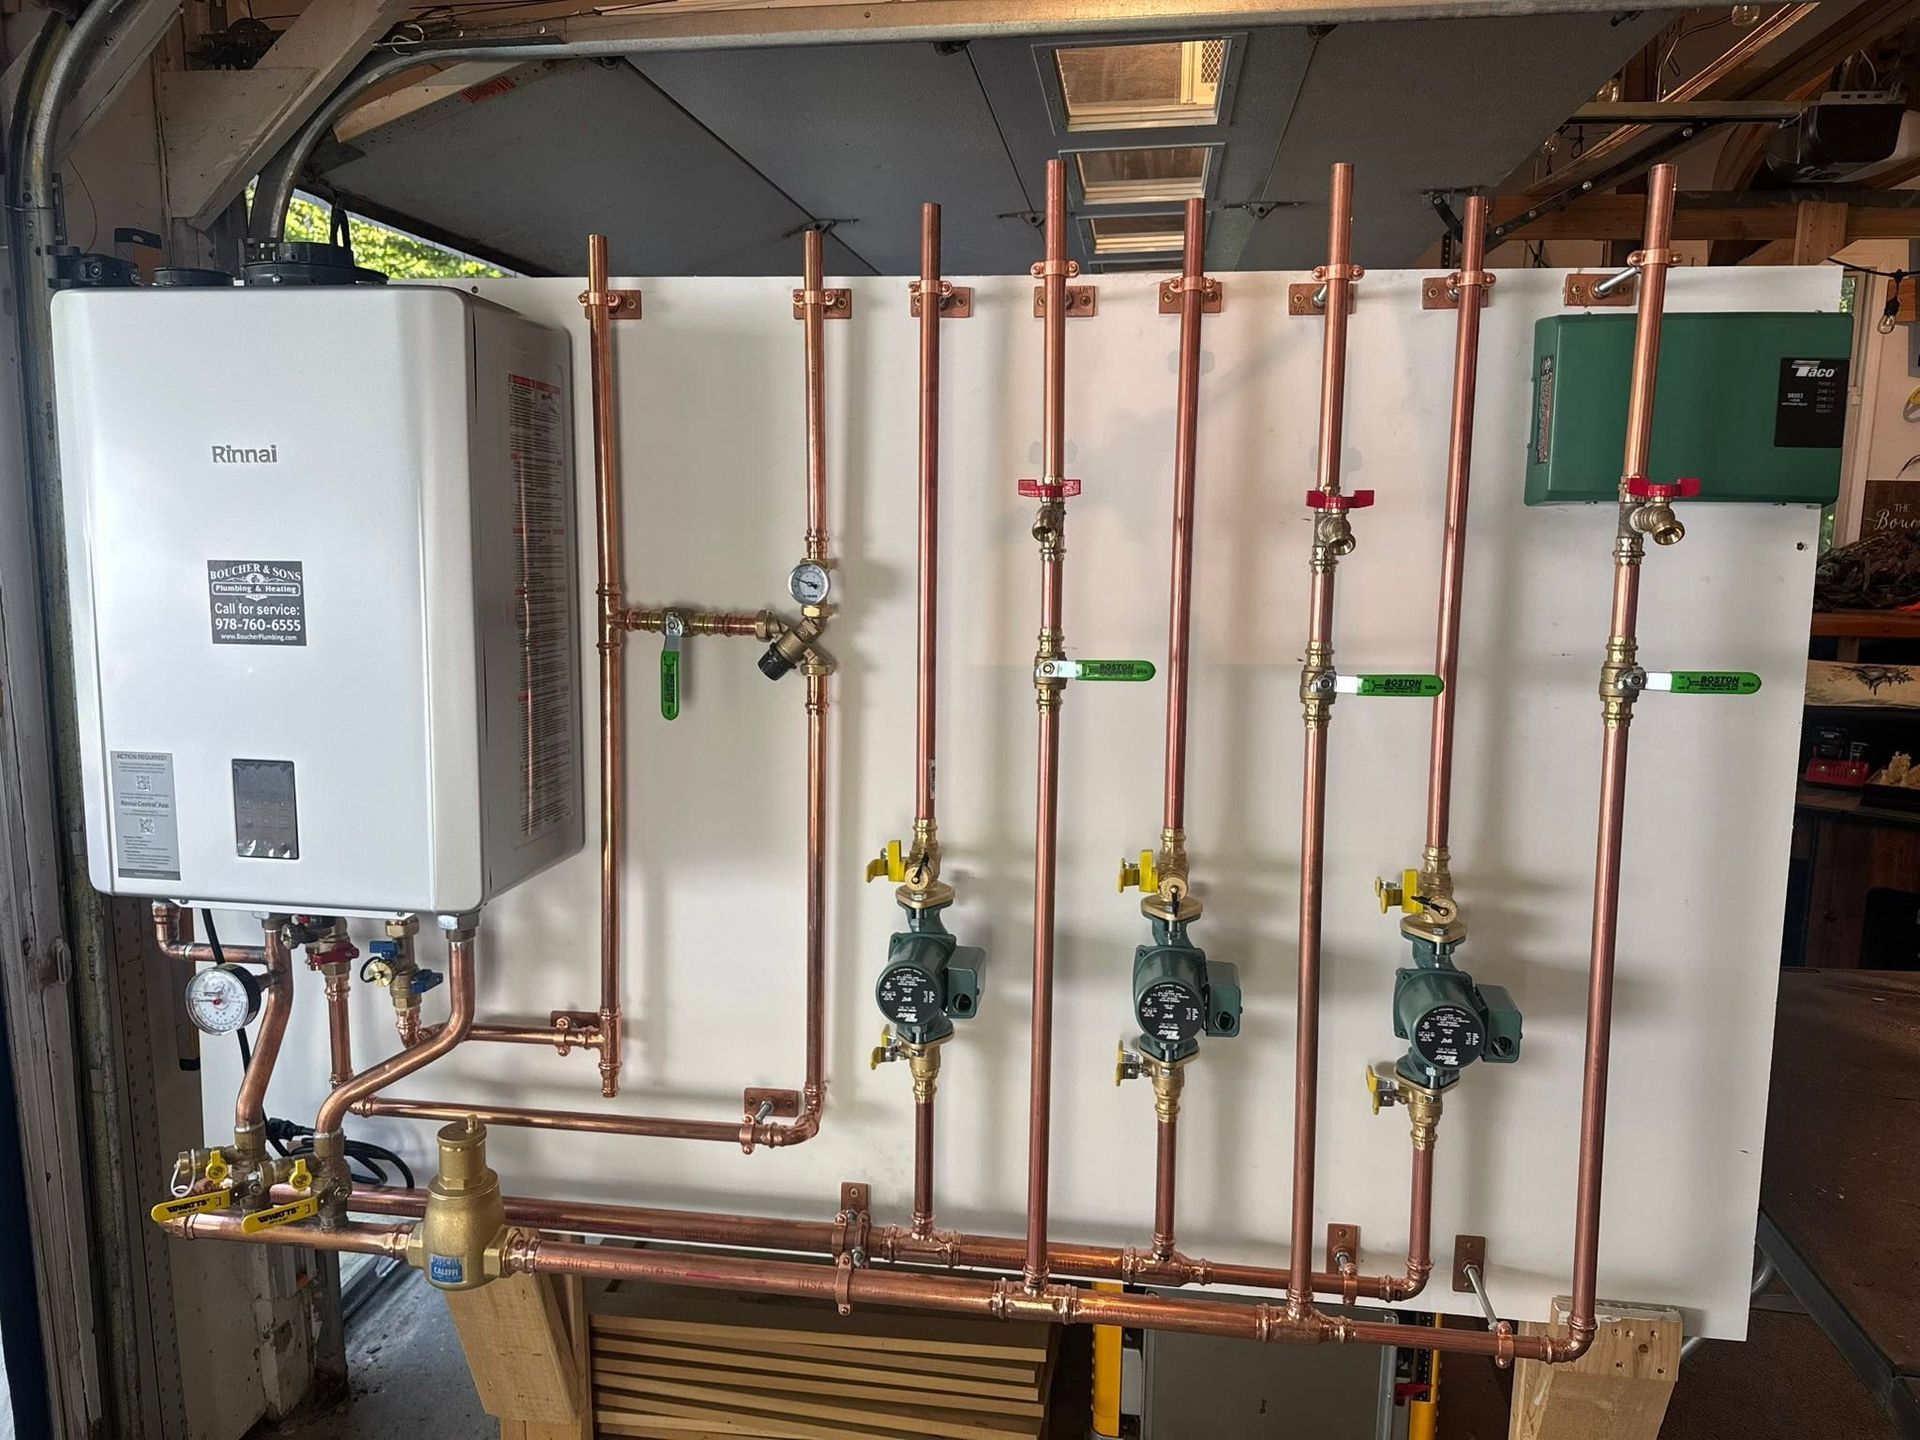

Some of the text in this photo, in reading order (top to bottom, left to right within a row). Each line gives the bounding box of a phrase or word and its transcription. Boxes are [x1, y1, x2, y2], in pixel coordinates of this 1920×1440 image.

[1791, 360, 1836, 378] Taco
[212, 444, 278, 463] Rinnai
[1894, 503, 1912, 512] THE
[210, 563, 301, 581] BOUCHER & SONS
[215, 584, 252, 593] Plumbing
[265, 585, 297, 594] Heating
[214, 602, 300, 616] Call for service:
[215, 618, 301, 631] 978-760-6555
[220, 633, 297, 641] www.BoucherPlumbing.com
[1384, 678, 1422, 687] BOSTON
[1701, 675, 1740, 684] BOSTON
